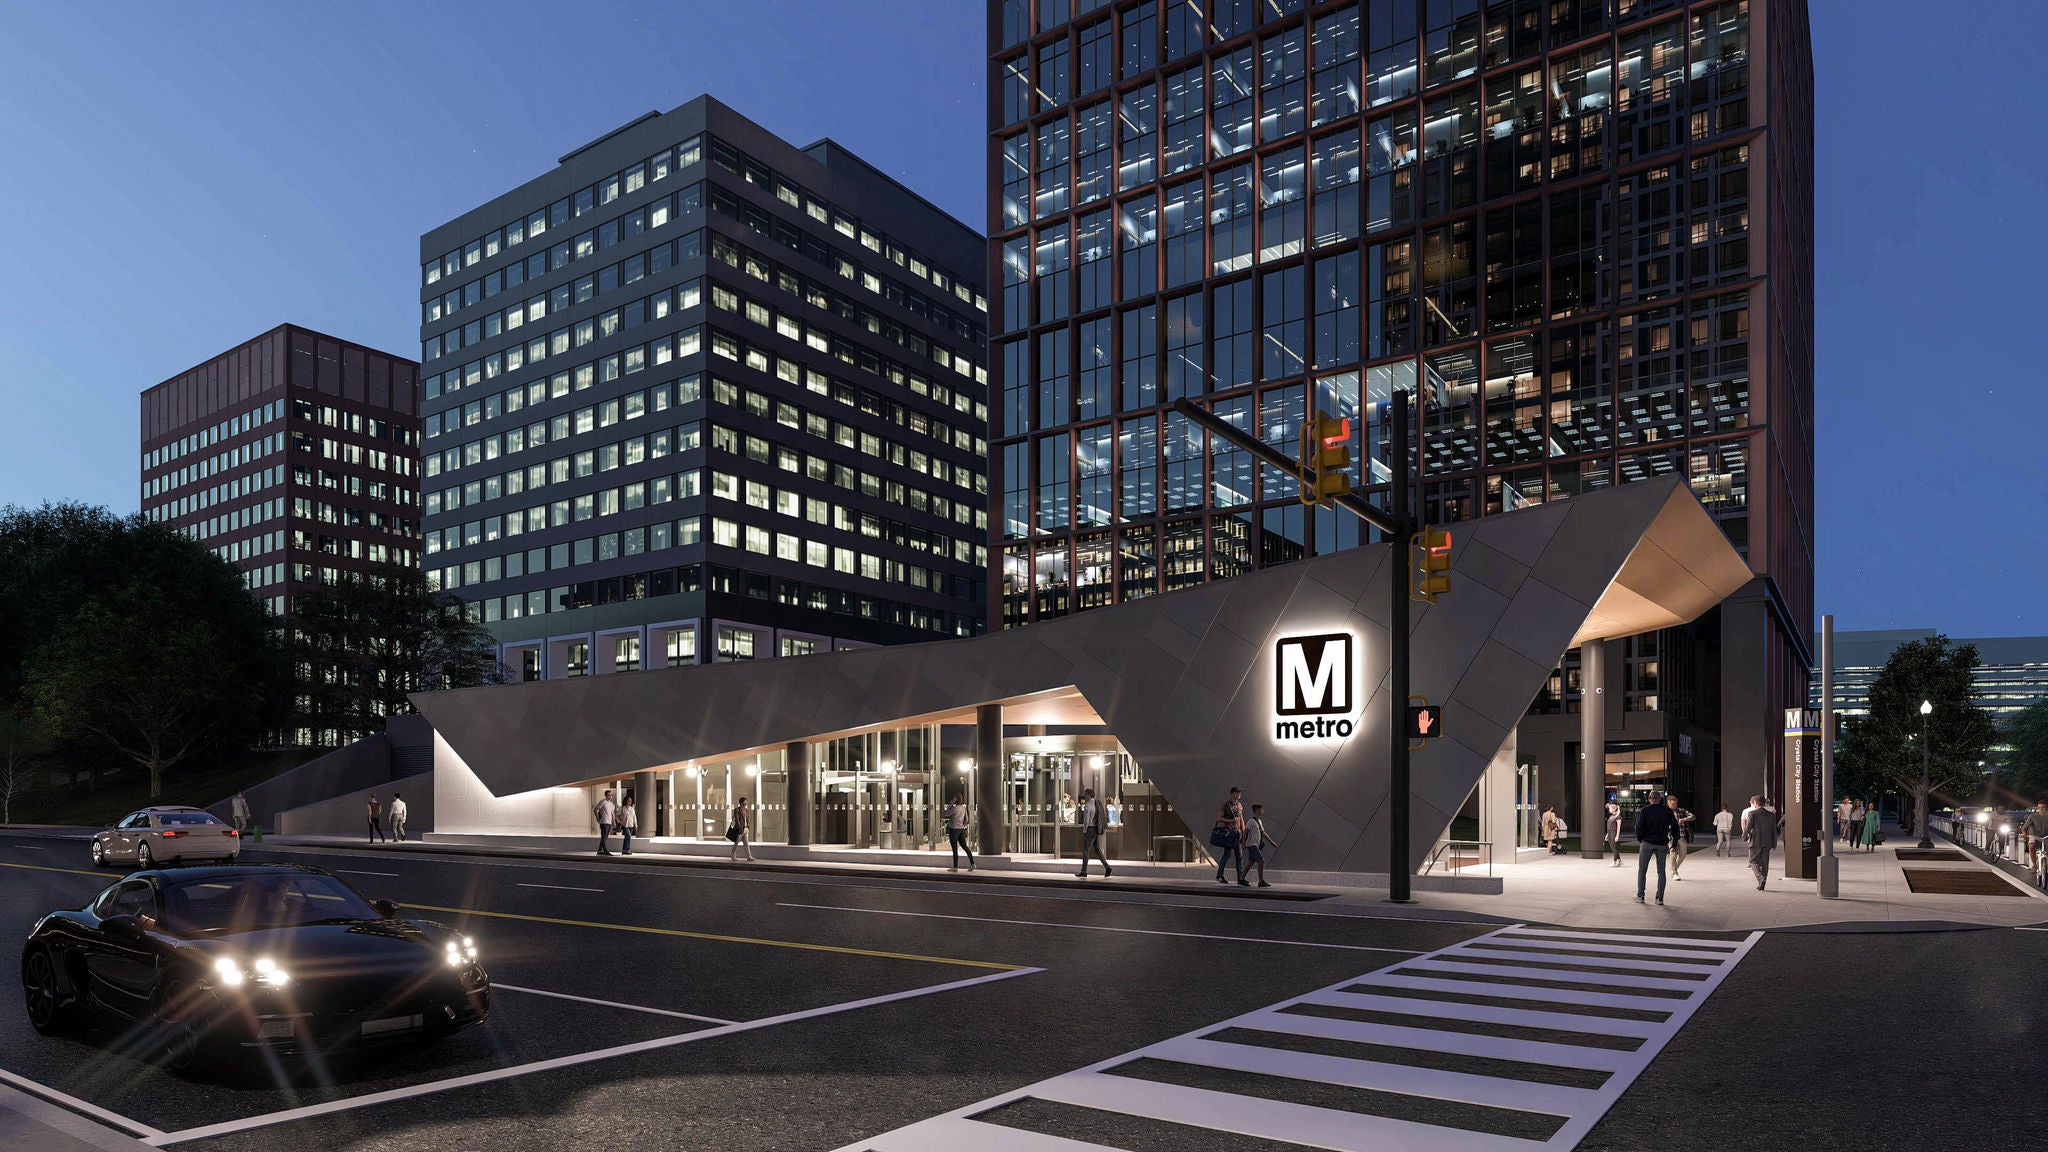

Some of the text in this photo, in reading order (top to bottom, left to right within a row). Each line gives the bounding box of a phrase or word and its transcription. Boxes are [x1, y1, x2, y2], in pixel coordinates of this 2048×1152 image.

[1282, 640, 1345, 709] M
[1276, 717, 1352, 739] metro
[1787, 711, 1800, 728] M
[1804, 711, 1819, 728] M
